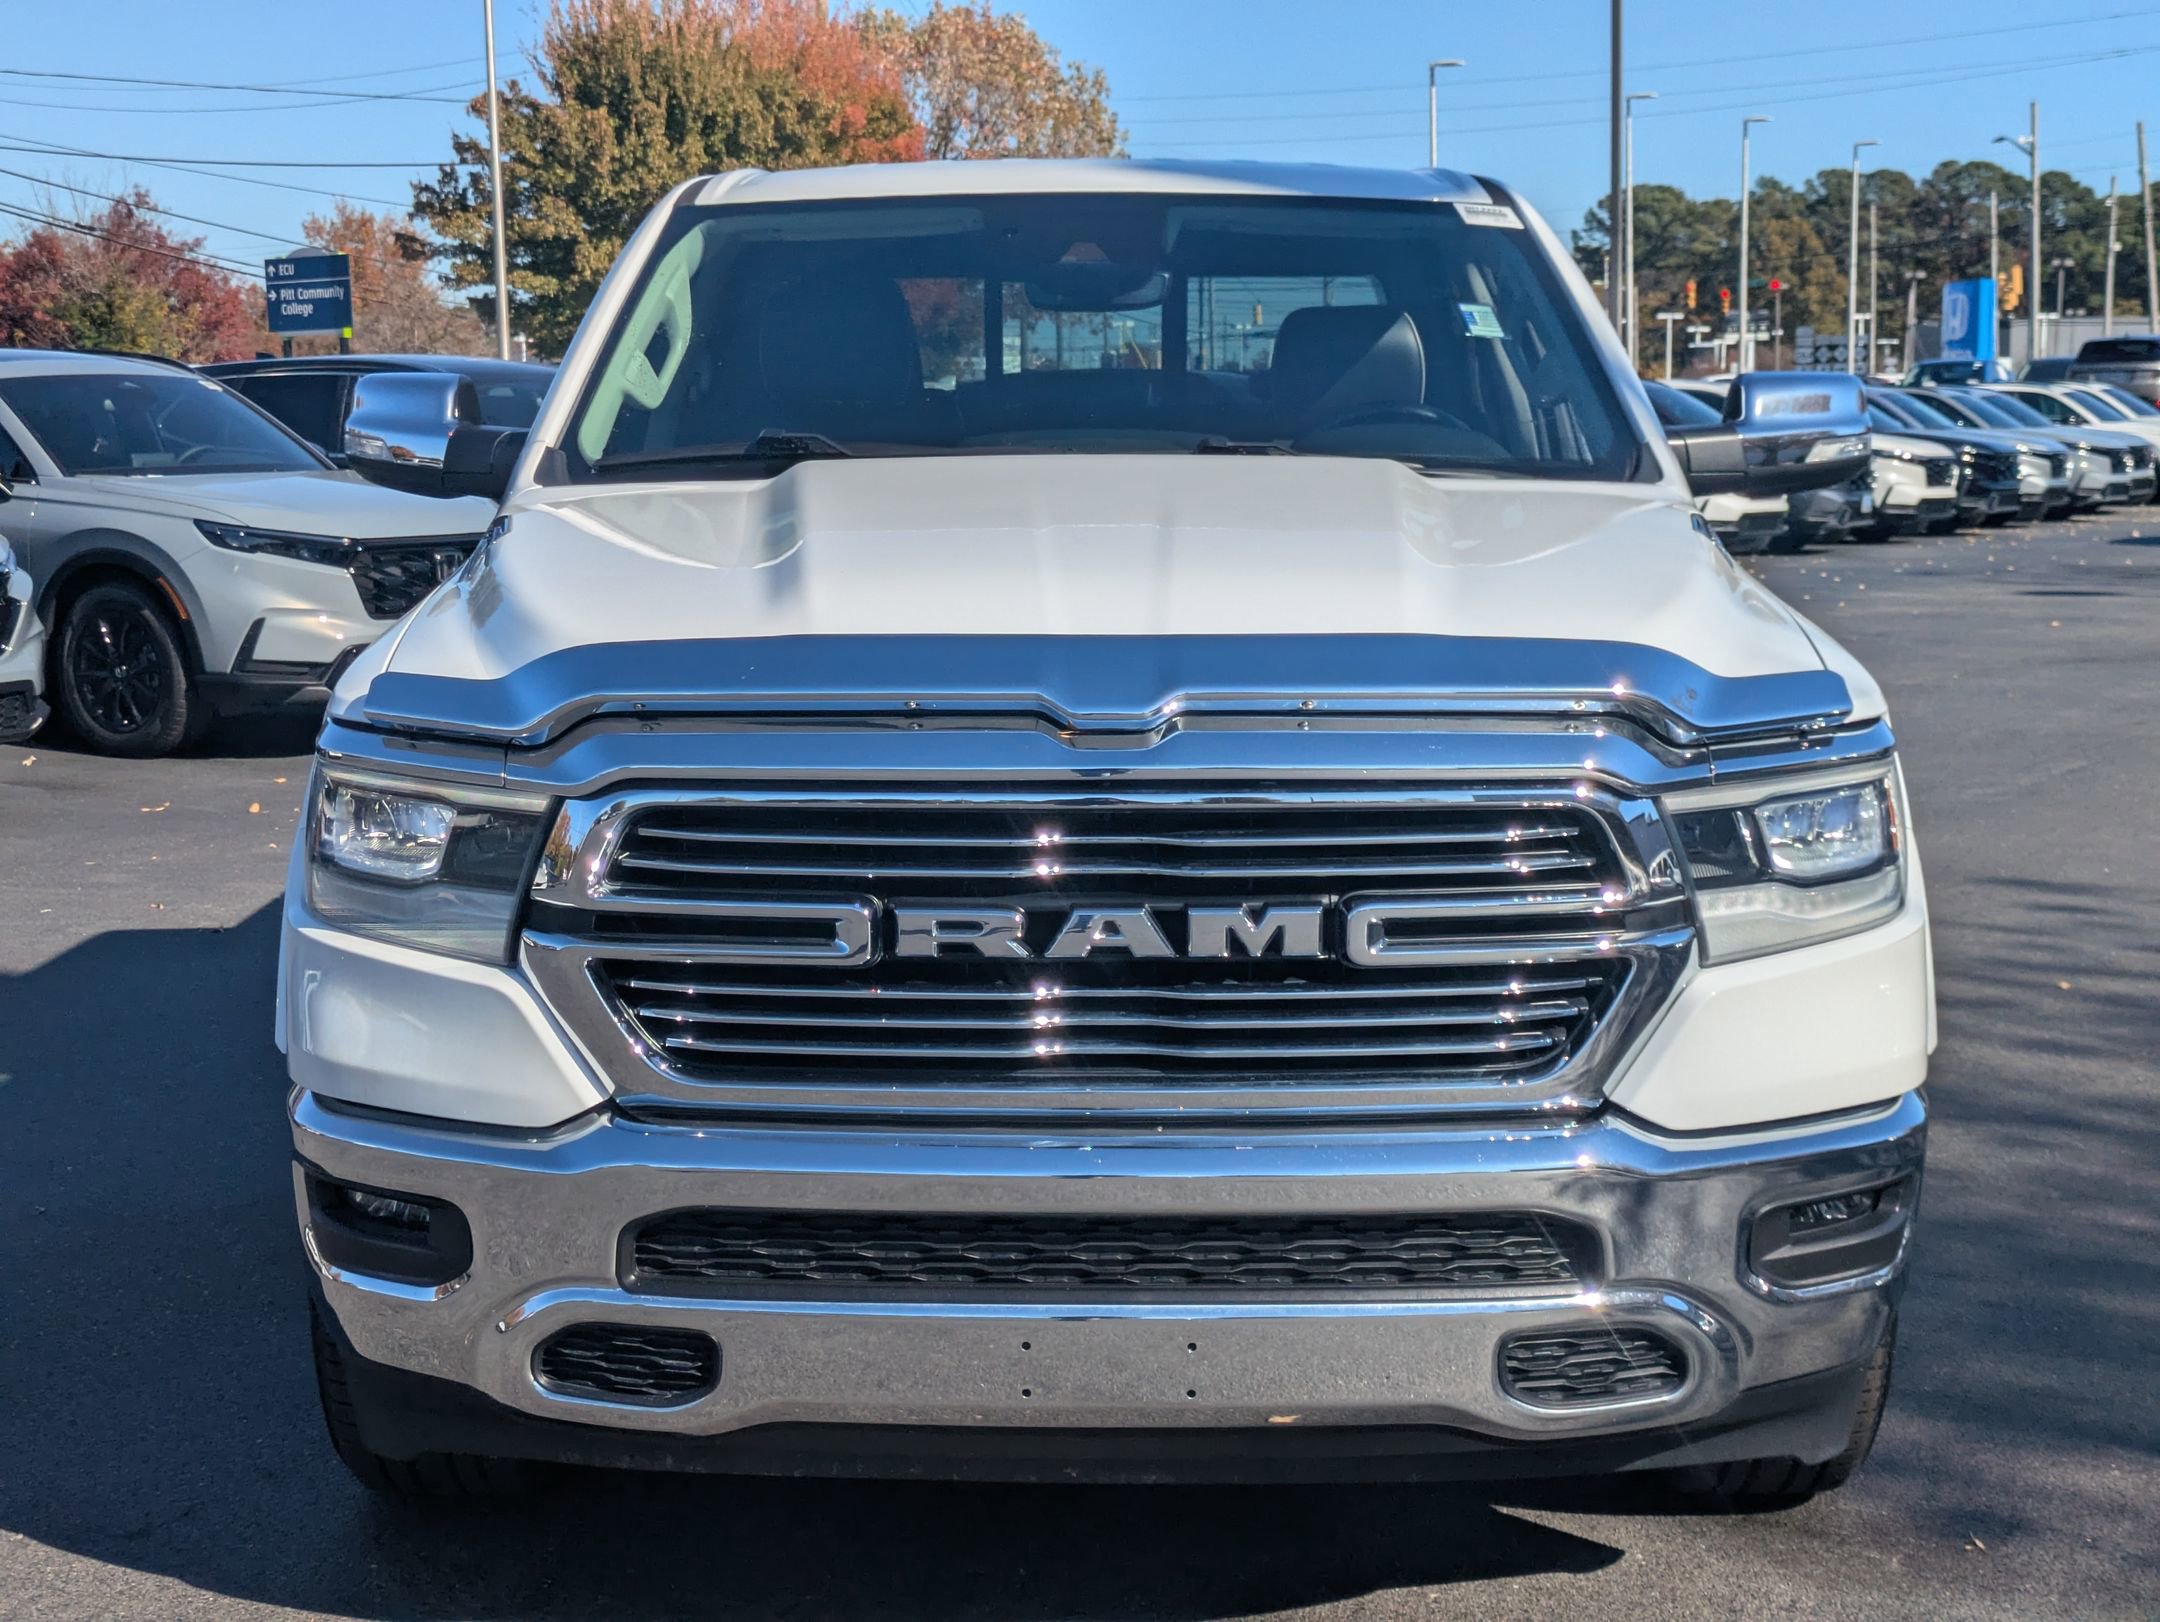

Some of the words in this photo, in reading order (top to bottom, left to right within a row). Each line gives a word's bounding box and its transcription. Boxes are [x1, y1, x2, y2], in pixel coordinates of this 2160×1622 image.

[278, 264, 295, 276] ECU
[280, 288, 295, 301] Pitt
[297, 286, 344, 300] Community
[281, 302, 314, 317] College
[894, 903, 1325, 959] RAM
